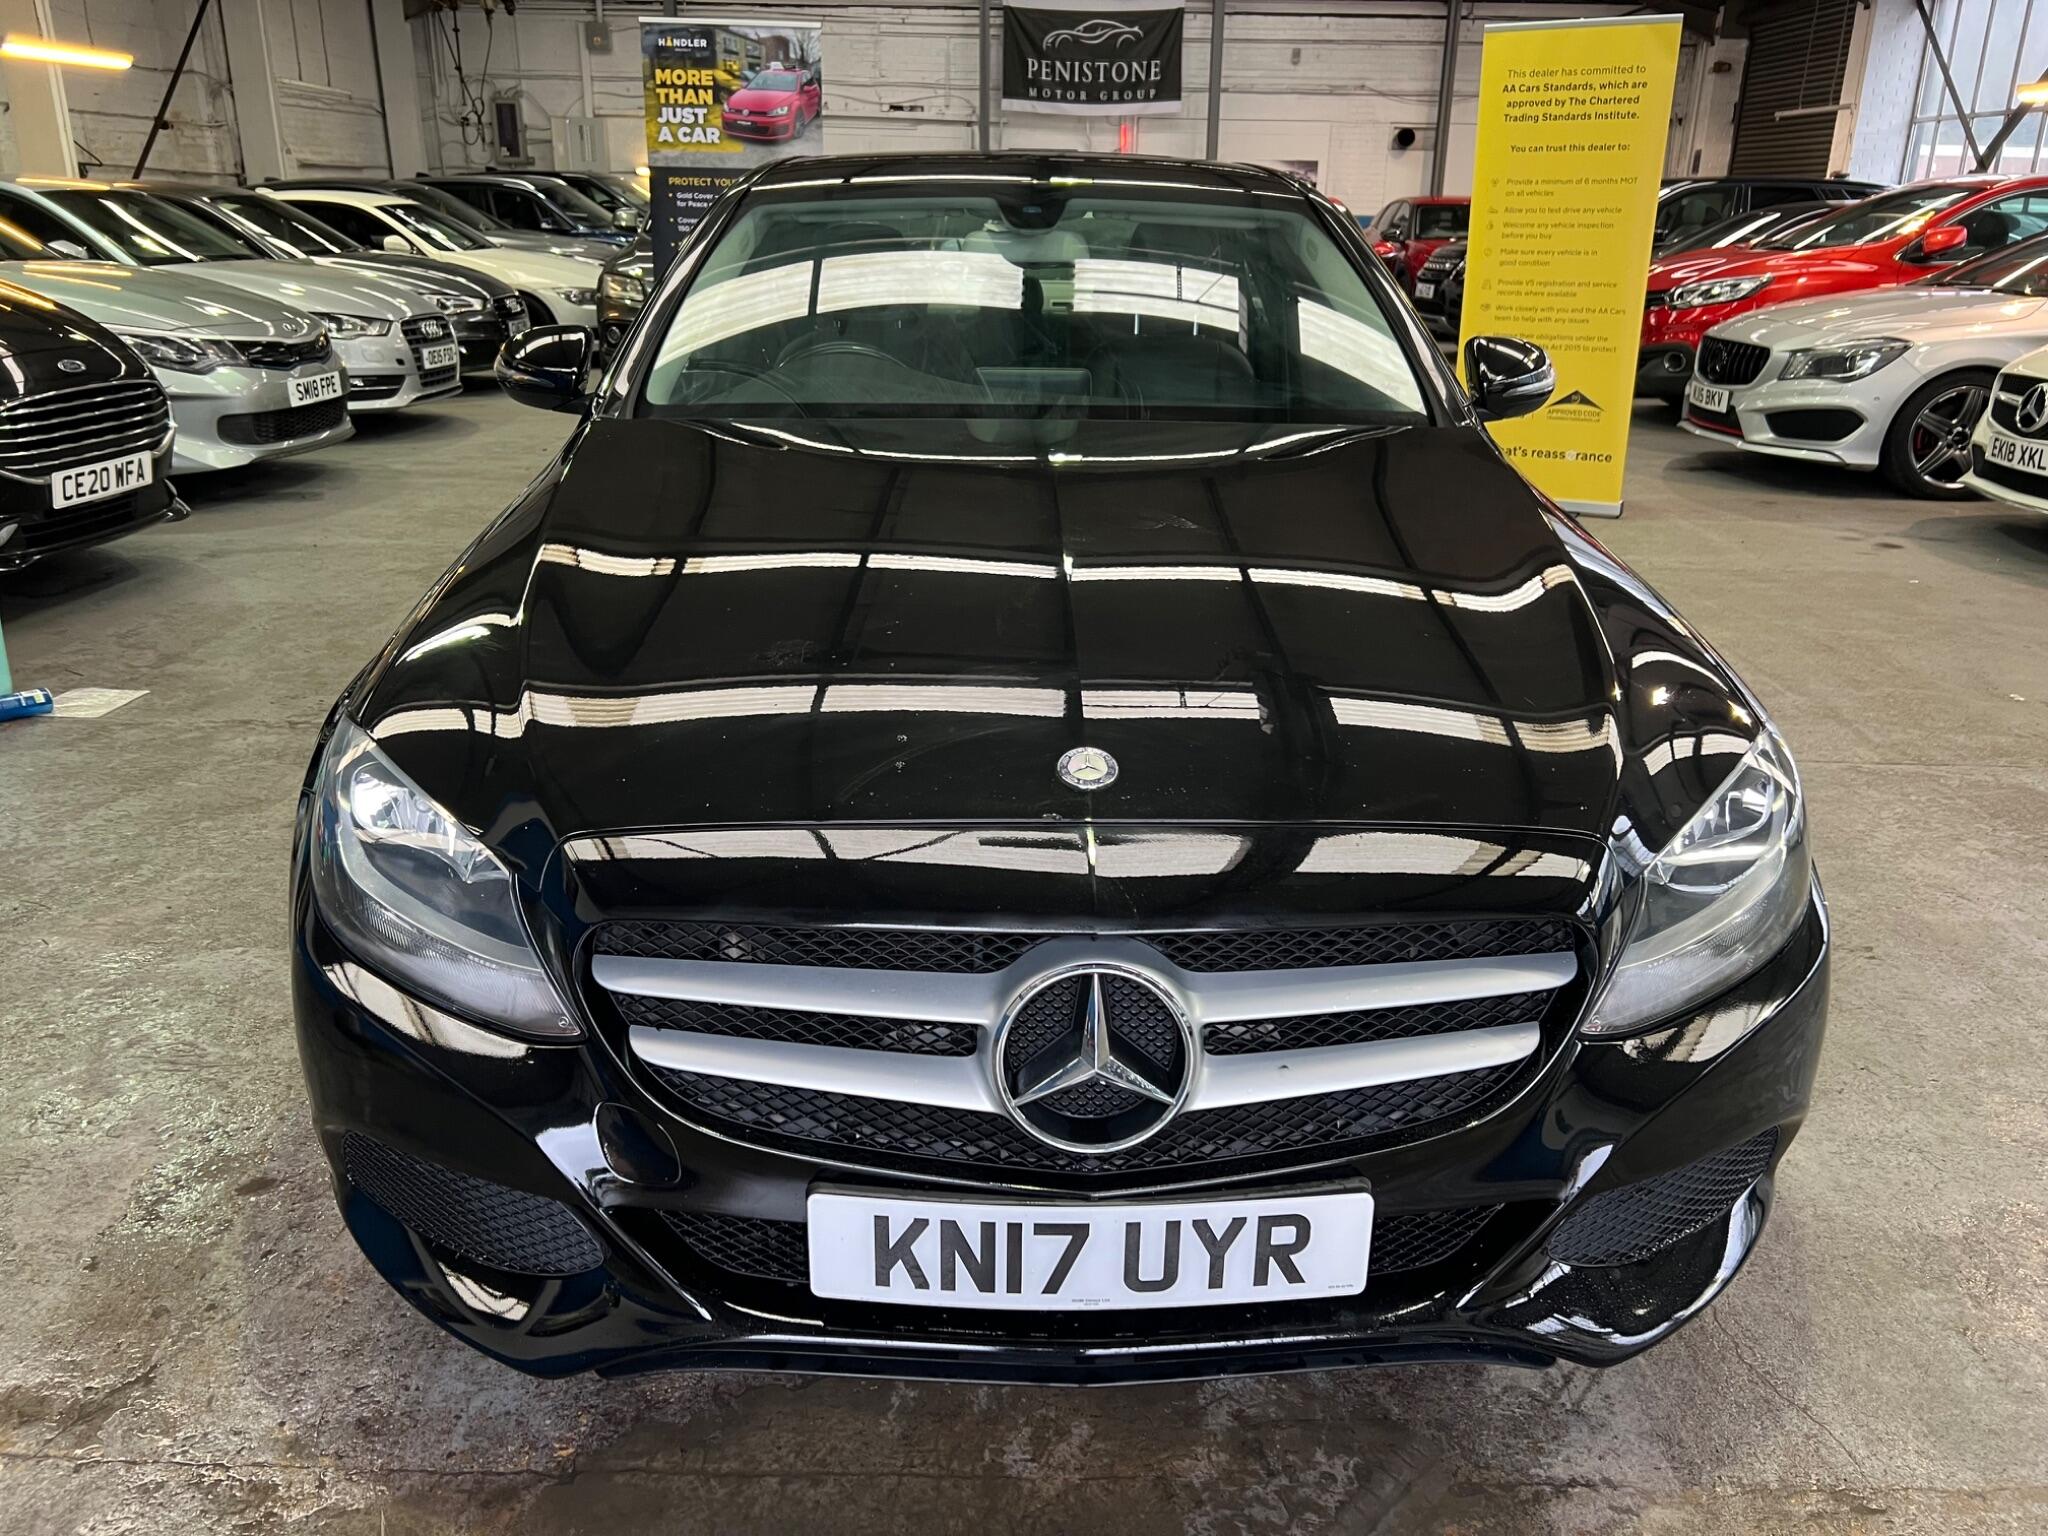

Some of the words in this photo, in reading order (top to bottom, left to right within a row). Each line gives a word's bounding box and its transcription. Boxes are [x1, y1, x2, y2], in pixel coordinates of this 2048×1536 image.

[1027, 57, 1162, 83] PENISTONE
[1507, 69, 1527, 79] This
[1529, 68, 1558, 78] dealer
[1561, 67, 1578, 77] has
[1580, 65, 1634, 76] committed
[1635, 65, 1647, 74] to
[655, 69, 714, 86] MORE
[1502, 84, 1516, 93] AA
[1518, 83, 1540, 93] Cars
[1543, 81, 1597, 92] Standards,
[1599, 80, 1629, 90] which
[1631, 81, 1648, 89] are
[655, 88, 714, 105] THAN
[1028, 87, 1087, 101] MOTOR
[1100, 88, 1157, 101] GROUP
[1506, 98, 1552, 109] approved
[1554, 97, 1567, 108] by
[1568, 96, 1587, 106] The
[1589, 95, 1641, 106] Chartered
[657, 107, 708, 125] JUST
[1503, 113, 1539, 124] Trading
[1541, 111, 1592, 122] Standards
[1594, 110, 1640, 121] Institute.
[658, 126, 673, 142] A
[677, 127, 721, 144] CAR
[1510, 145, 1526, 153] You
[1546, 144, 1567, 152] trust
[1569, 143, 1586, 152] this
[1588, 143, 1616, 152] dealer
[1617, 143, 1631, 151] to:
[668, 177, 713, 187] PROTECT
[1506, 178, 1533, 186] Provide
[1575, 177, 1584, 185] of
[1591, 177, 1619, 185] months
[1620, 176, 1639, 185] MOT
[1525, 189, 1554, 197] vehicles
[1525, 207, 1538, 215] you
[1547, 206, 1561, 214] test
[1562, 206, 1581, 214] drive
[1582, 207, 1595, 215] any
[1596, 207, 1623, 215] vehicle
[1576, 222, 1614, 230] inspection
[1501, 232, 1524, 240] before
[1525, 233, 1538, 241] you
[1539, 232, 1552, 240] buy
[1536, 249, 1556, 257] every
[1557, 248, 1582, 256] vehicle
[1590, 248, 1599, 256] in
[1535, 280, 1576, 289] registration
[1576, 280, 1591, 288] and
[1592, 280, 1618, 288] service
[1546, 290, 1577, 298] available
[1514, 305, 1539, 314] closely
[1556, 307, 1569, 315] you
[1570, 306, 1584, 314] and
[1584, 306, 1597, 314] the
[1609, 307, 1626, 315] Cars
[1521, 315, 1536, 323] help
[1554, 317, 1566, 325] any
[1590, 345, 1617, 354] protect
[295, 379, 320, 401] SM18
[320, 375, 337, 396] FPE
[1704, 389, 1724, 408] BKV
[1546, 408, 1583, 418] APPROVED
[1583, 409, 1602, 418] CODE
[1991, 437, 2017, 463] EK18
[2017, 444, 2047, 471] XKL
[62, 466, 110, 502] CE20
[114, 457, 146, 489] WFA
[873, 1214, 1091, 1296] KN17
[1122, 1212, 1313, 1294] UYR
